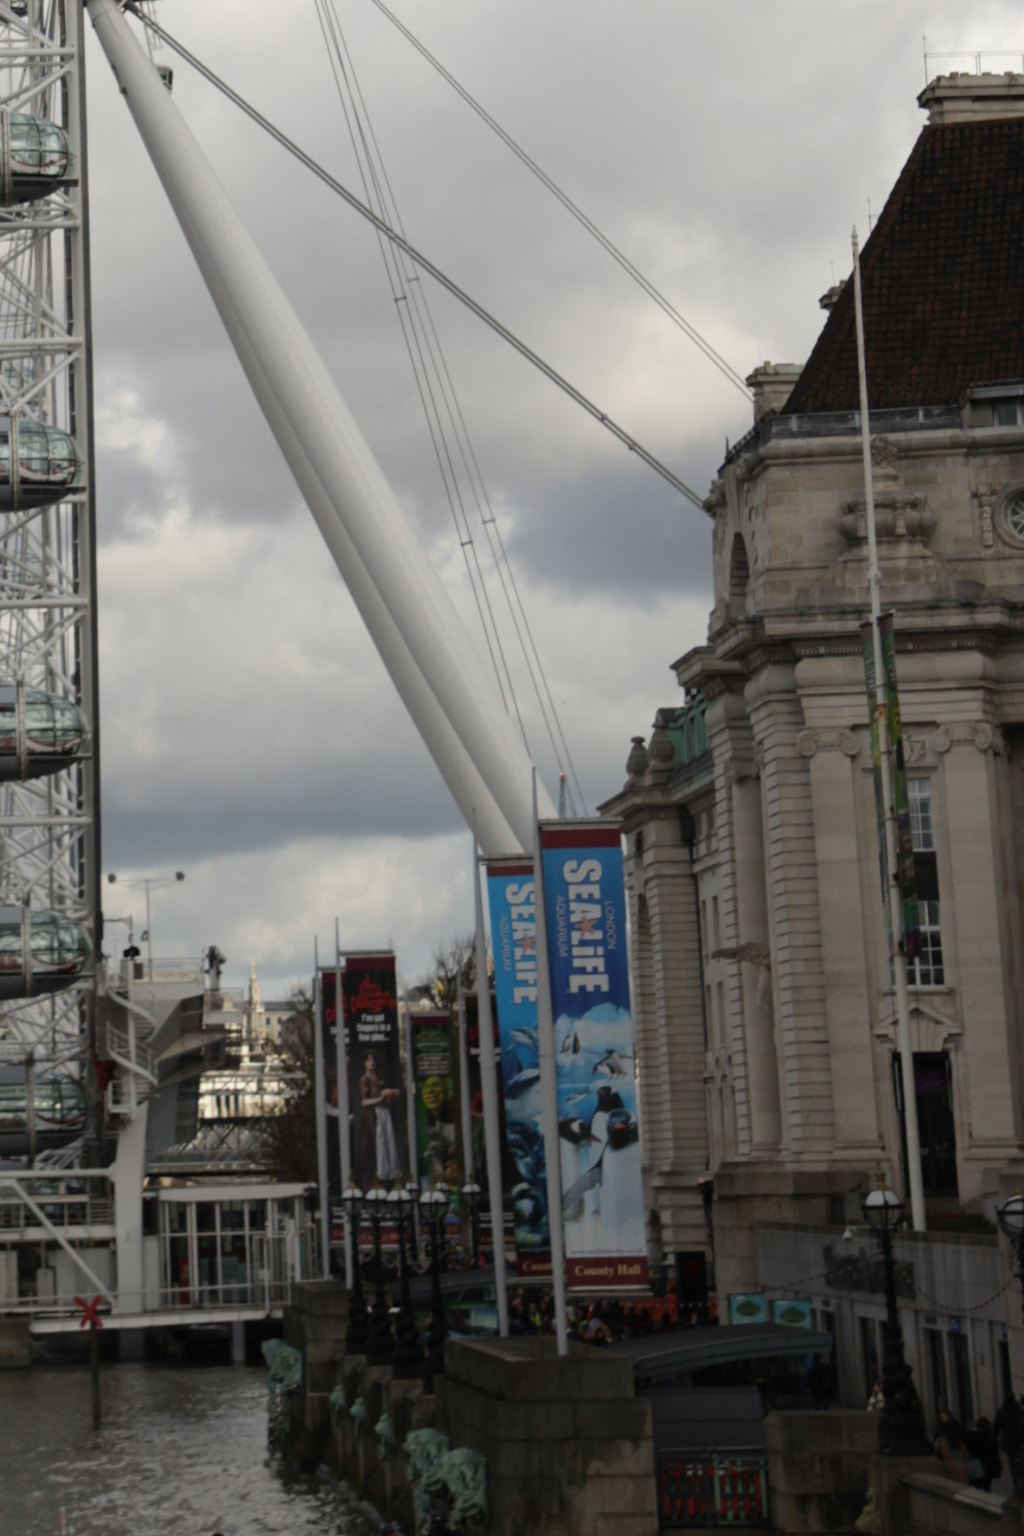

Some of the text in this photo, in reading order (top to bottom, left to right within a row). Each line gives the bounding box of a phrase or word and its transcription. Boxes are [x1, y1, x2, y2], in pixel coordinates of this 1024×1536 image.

[505, 882, 536, 941] SEA
[562, 858, 603, 923] SEA
[499, 915, 511, 972] AQUARIUM
[555, 895, 568, 958] AQUARIUM
[604, 900, 616, 950] LONDON
[522, 1261, 553, 1272] Count
[574, 1264, 641, 1279] County Hall
